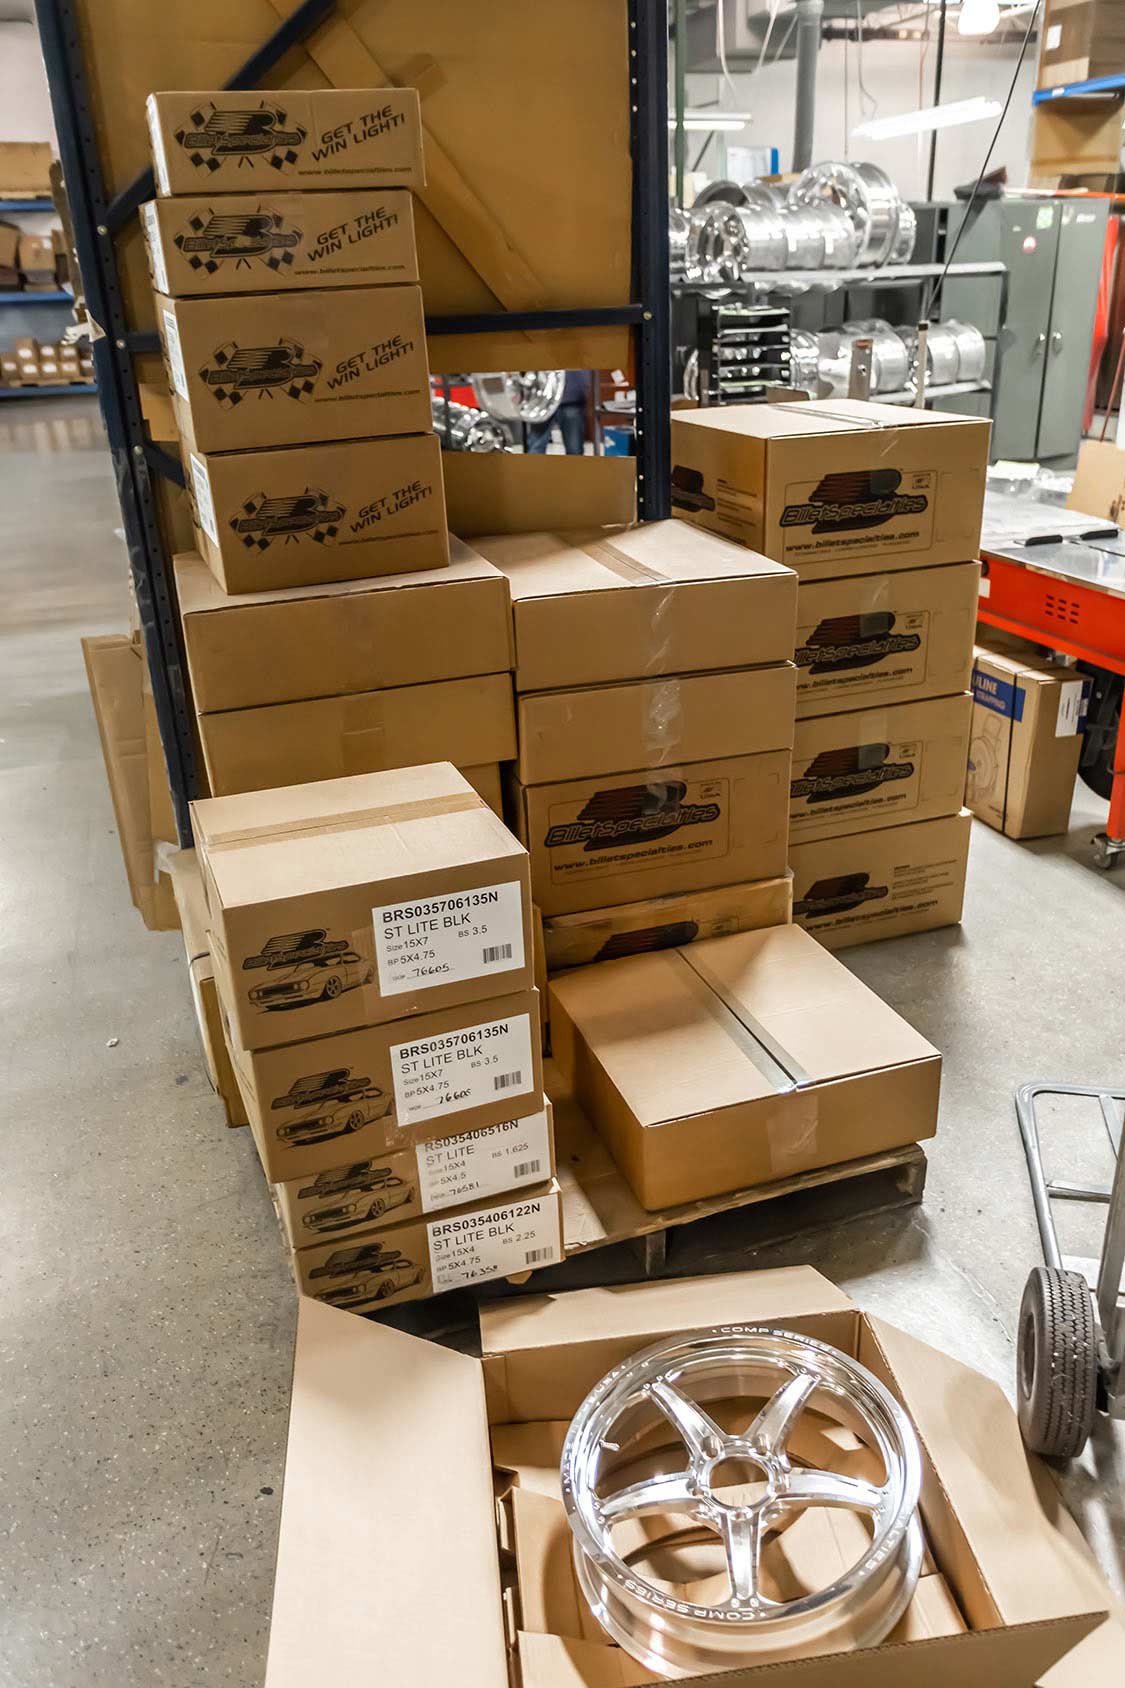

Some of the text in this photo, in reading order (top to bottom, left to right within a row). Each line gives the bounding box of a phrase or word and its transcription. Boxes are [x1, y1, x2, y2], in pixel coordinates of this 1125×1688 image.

[312, 113, 406, 162] WIN LIGHT!
[321, 105, 394, 144] GET THE
[308, 239, 342, 262] WIN
[348, 213, 399, 244] LIGHT!
[317, 223, 349, 245] GET
[354, 206, 388, 228] THE
[327, 368, 360, 390] WIN
[366, 341, 415, 371] LIGHT!
[336, 335, 404, 374] GET THE
[350, 512, 381, 533] WIN
[387, 486, 433, 516] LIGHT!
[358, 480, 423, 518] GET THE
[786, 530, 919, 552] www.billetspecialties.com
[547, 805, 718, 846] BilletSpecialties
[553, 839, 713, 872] www.billetspecialties.com
[383, 891, 498, 923] BRS035706135N
[385, 913, 471, 939] ST LITE BLK
[458, 925, 488, 938] BS 3.5
[404, 937, 429, 948] 15X7
[400, 950, 436, 964] 5X4.75
[412, 963, 450, 977] 76605
[400, 1024, 509, 1059] BRS035706135N
[401, 1045, 483, 1074] ST LITE BLK
[484, 1055, 499, 1066] 3.5
[416, 1081, 449, 1096] 5X4.75
[419, 1069, 443, 1081] 15X7
[426, 1144, 475, 1167] ST LITE
[505, 1143, 529, 1156] 1.625
[444, 1160, 466, 1172] 15X4
[432, 1203, 541, 1237] BRS035406122N
[433, 1223, 515, 1251] ST LITE BLK
[516, 1231, 536, 1242] 2.25
[452, 1246, 475, 1257] 15X4
[721, 1326, 832, 1351] COMP SERIES
[624, 1579, 755, 1621] COMP SERIES
